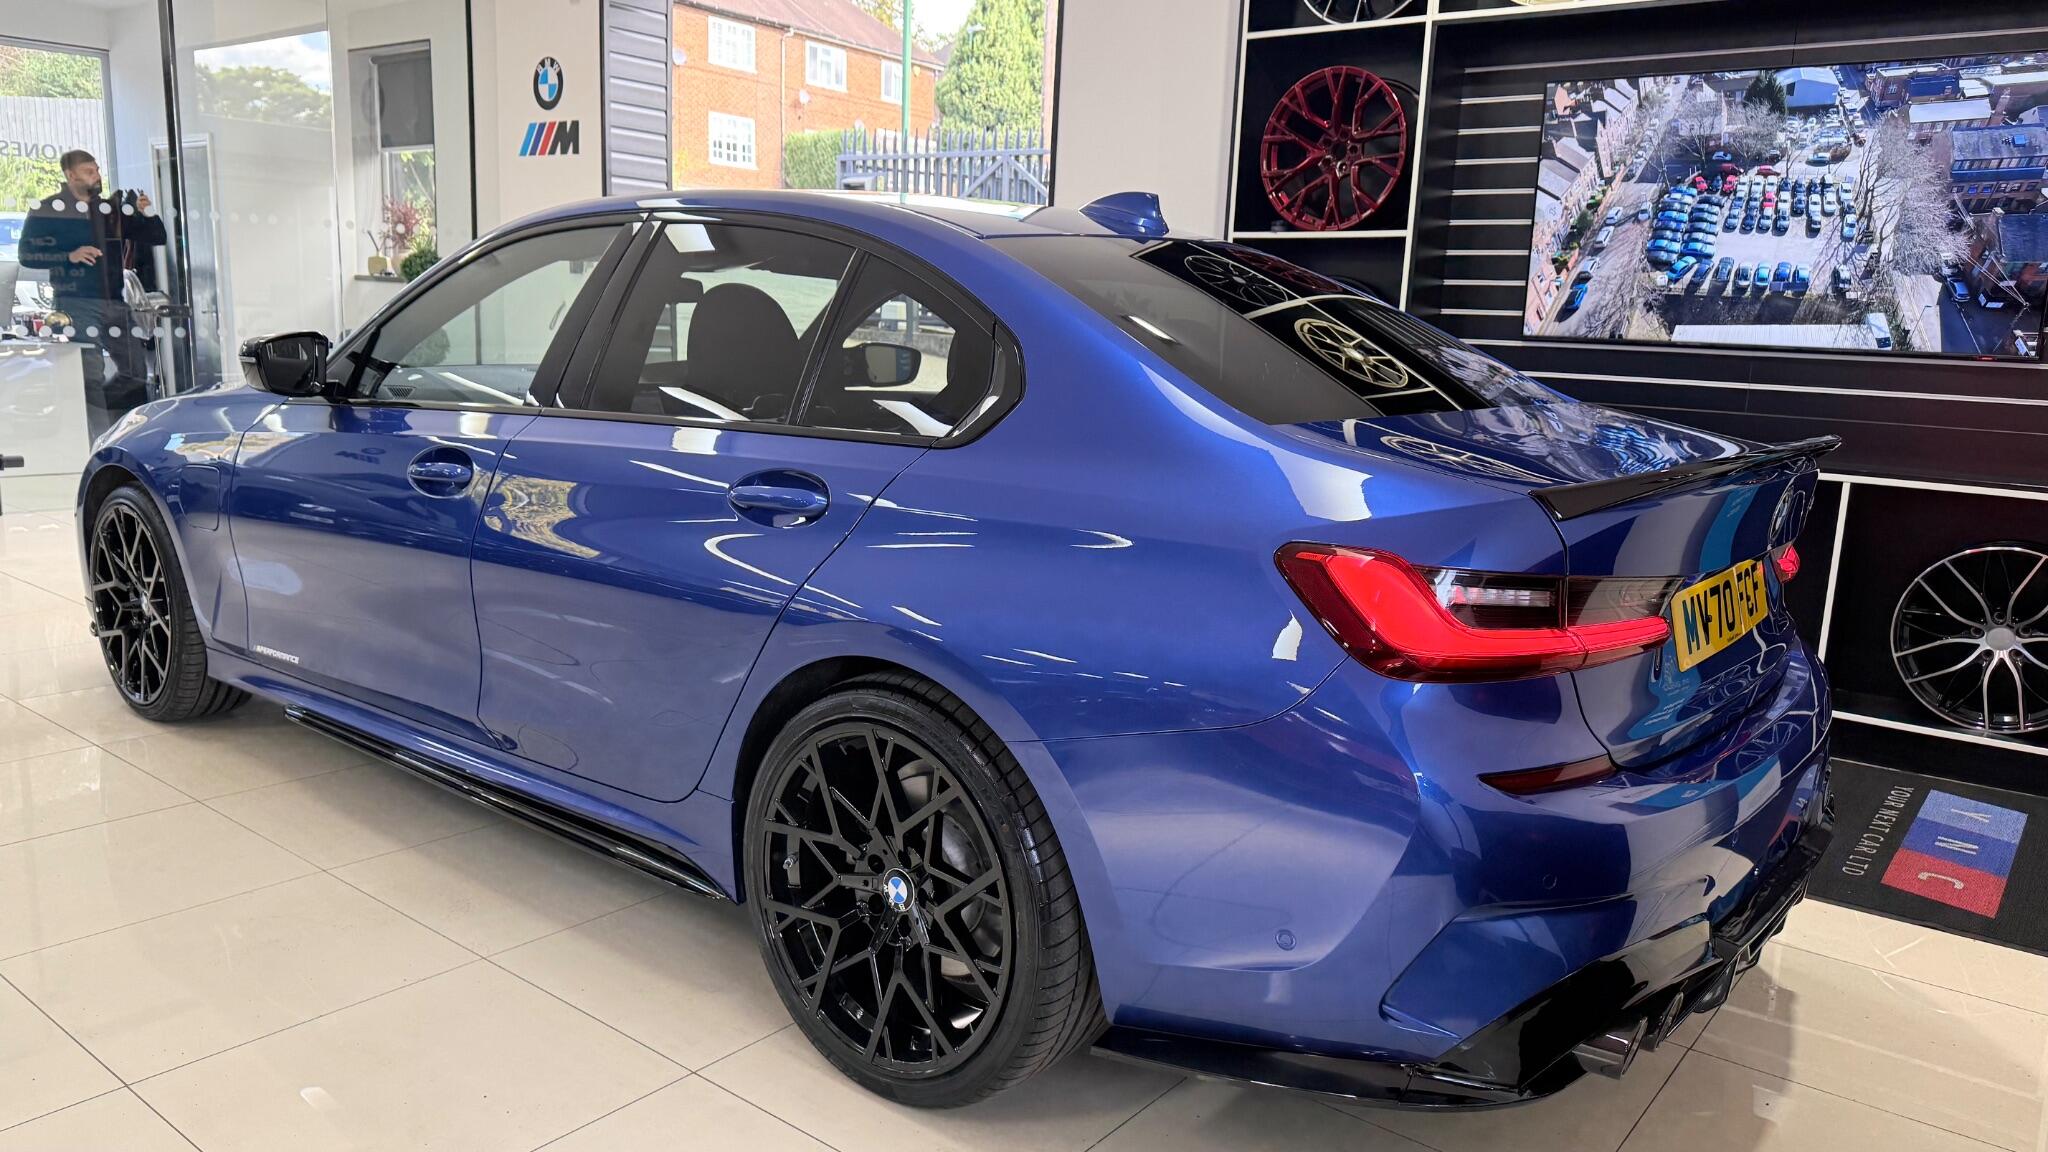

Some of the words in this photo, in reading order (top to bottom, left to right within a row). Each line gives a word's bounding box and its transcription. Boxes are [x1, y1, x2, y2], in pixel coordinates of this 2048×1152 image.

[1682, 579, 1736, 655] MV70
[1883, 785, 1915, 809] YOUR
[1868, 808, 1901, 833] NEXT
[1854, 833, 1884, 855] CAR
[1842, 854, 1872, 876] LTD
